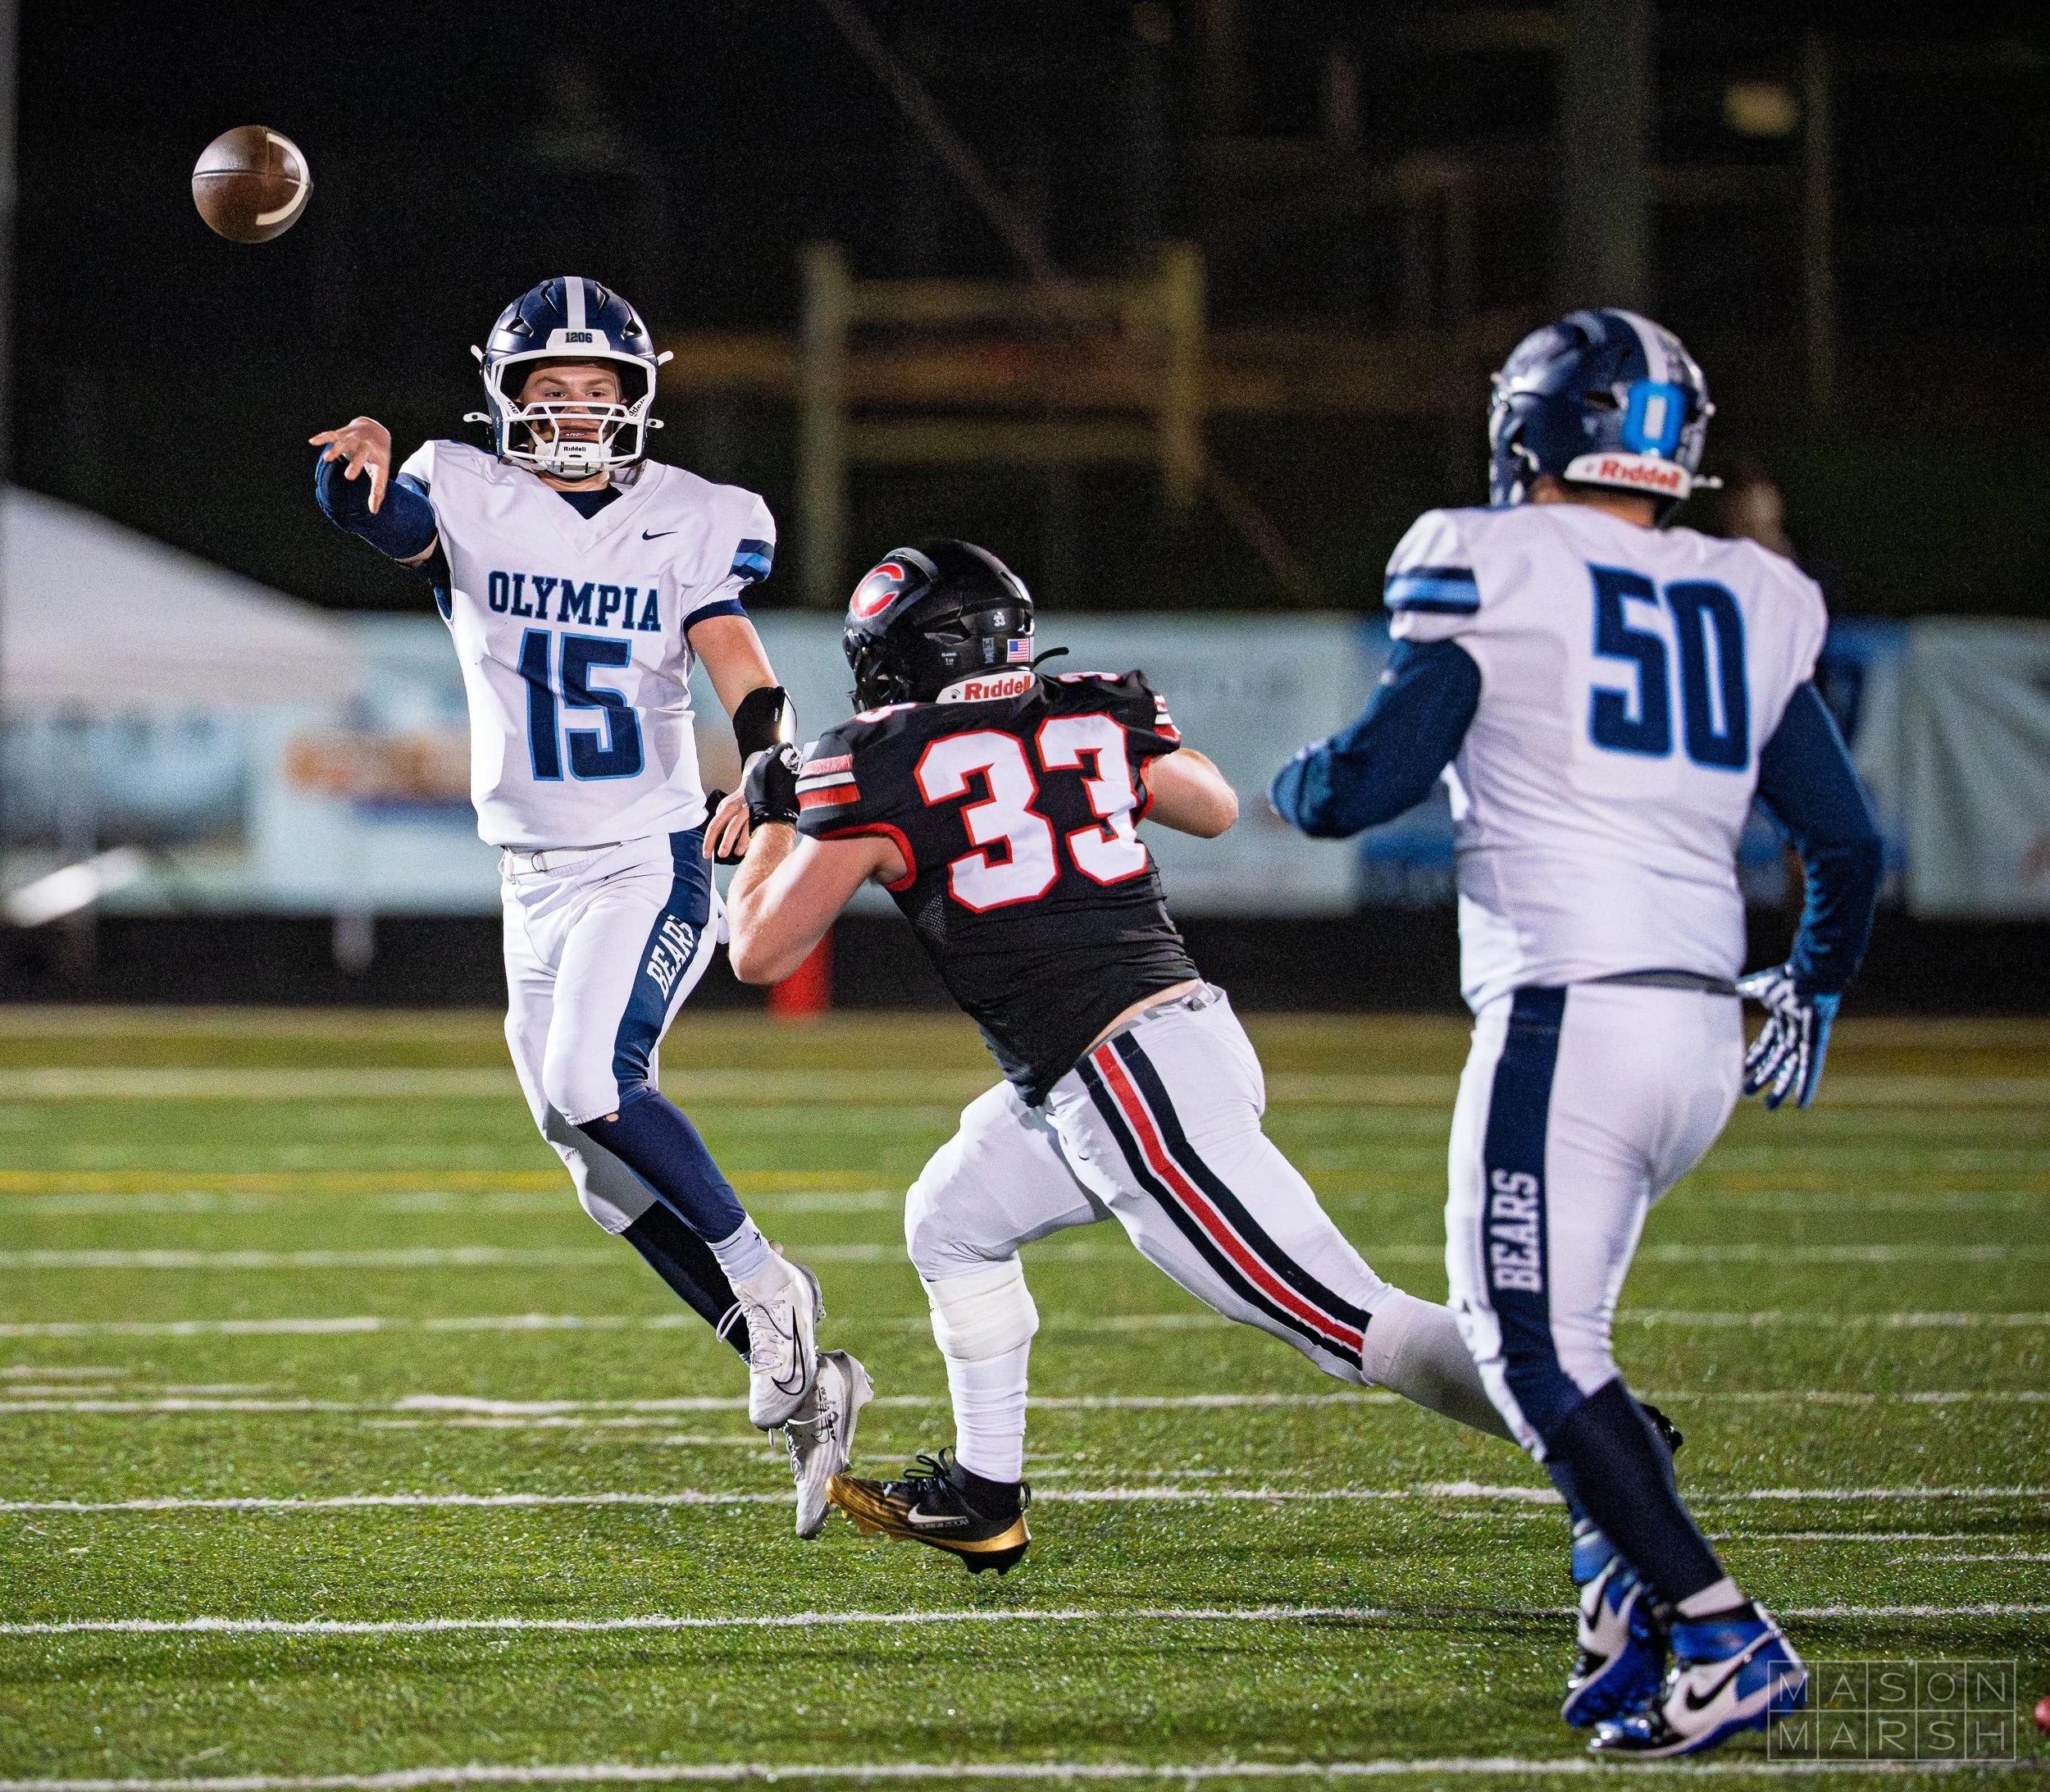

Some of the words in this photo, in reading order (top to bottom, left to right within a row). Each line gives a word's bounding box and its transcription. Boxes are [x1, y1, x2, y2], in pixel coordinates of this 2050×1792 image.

[565, 331, 594, 344] 1206
[1600, 458, 1682, 490] Riddell
[488, 569, 663, 632] OLYMPIA
[517, 626, 646, 782] 15
[963, 675, 1032, 701] Riddell
[1586, 560, 1751, 774] 50
[913, 710, 1149, 914] 33
[1489, 1167, 1542, 1294] BEARS
